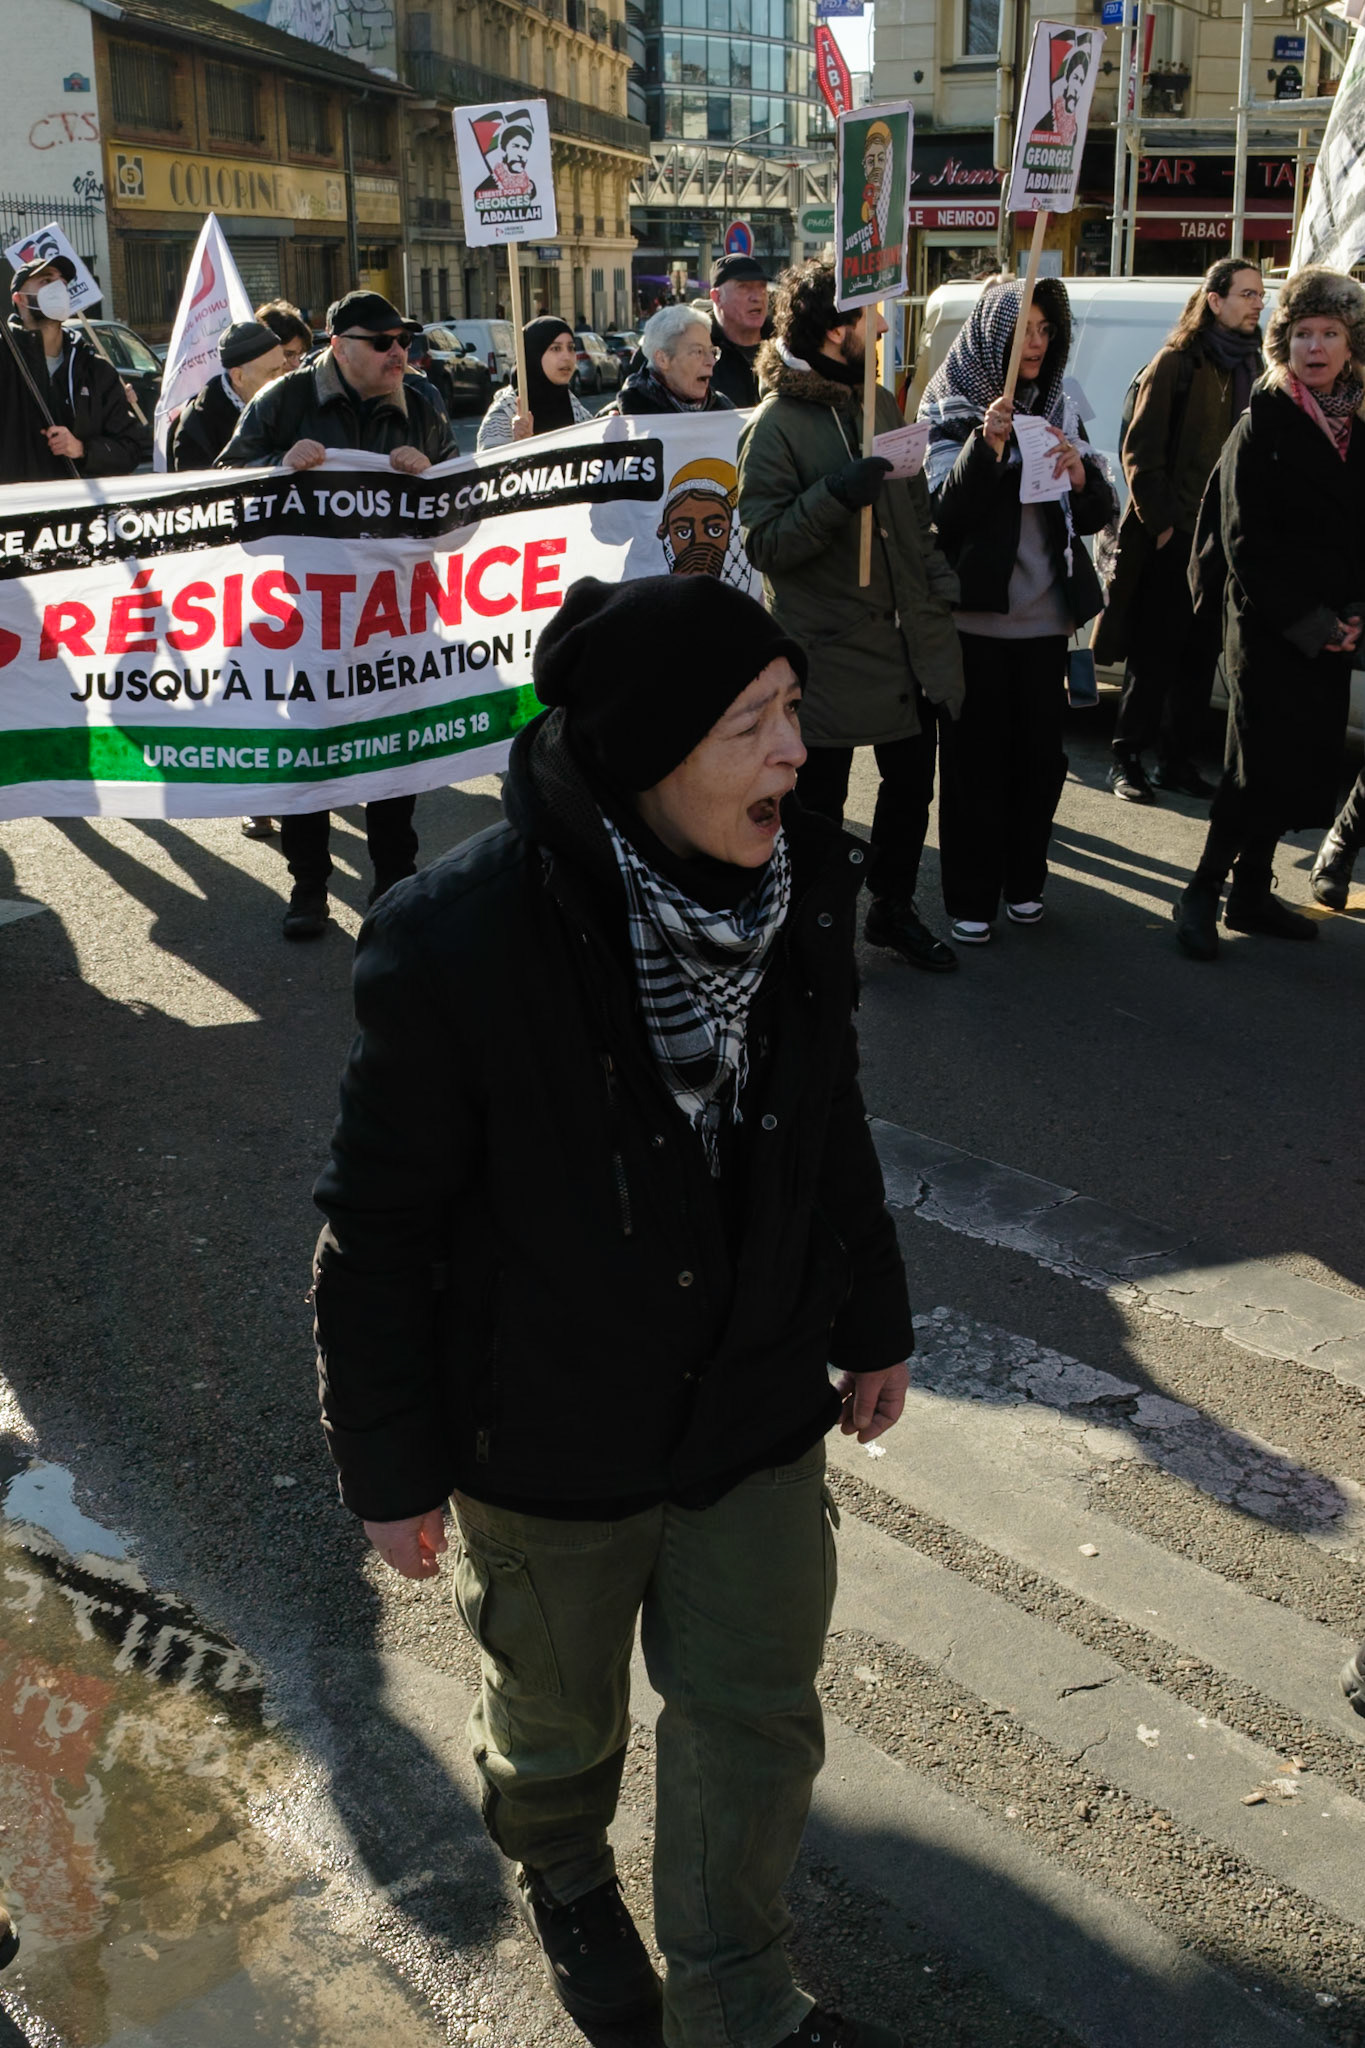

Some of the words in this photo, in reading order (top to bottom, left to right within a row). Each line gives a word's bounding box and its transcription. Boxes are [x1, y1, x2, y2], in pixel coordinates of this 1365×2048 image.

[1105, 3, 1119, 14] FDJ
[1026, 147, 1072, 167] GEORGES
[1138, 158, 1197, 184] BAR
[1027, 172, 1073, 190] ABDALLAH
[503, 188, 521, 196] POUR
[475, 195, 530, 210] GEORGES
[482, 208, 541, 223] ABDALLAH
[907, 210, 923, 225] LE
[938, 210, 995, 226] NEMROD
[845, 223, 873, 251] JUSTICE
[1180, 222, 1226, 238] TABAC
[861, 240, 872, 254] EN
[33, 524, 81, 553] AU
[88, 500, 237, 546] SIONISME
[244, 494, 278, 523] ET
[281, 485, 305, 514] À
[313, 489, 391, 518] TOUS
[399, 493, 450, 520] LES
[455, 456, 656, 510] COLONIALISMES
[39, 537, 567, 661] RÉSISTANCE
[265, 669, 316, 702] LA
[327, 633, 514, 700] LIBÉRATION
[143, 745, 270, 769] URGENCE
[277, 733, 402, 769] PALESTINE
[408, 718, 466, 751] PARIS
[469, 711, 490, 734] 18
